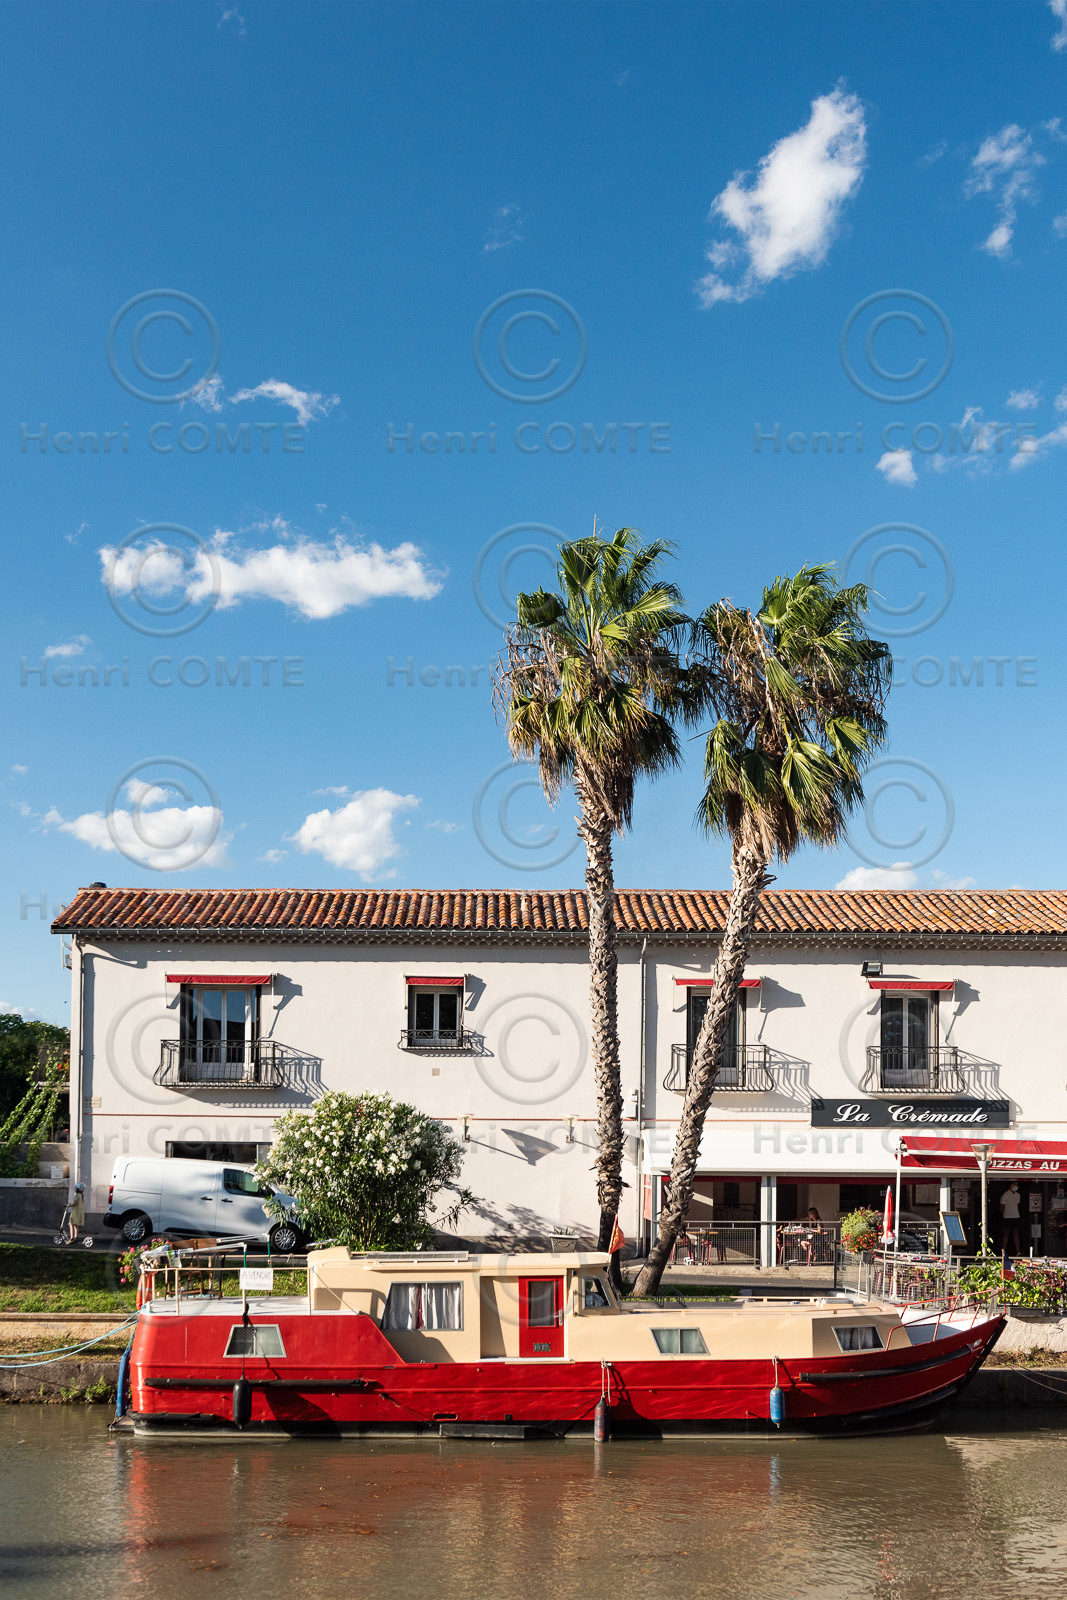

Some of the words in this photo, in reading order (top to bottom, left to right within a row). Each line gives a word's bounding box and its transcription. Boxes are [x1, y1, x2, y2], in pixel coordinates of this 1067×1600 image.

[833, 1104, 871, 1123] La
[887, 1104, 989, 1123] Crémade
[1039, 1161, 1060, 1170] AU
